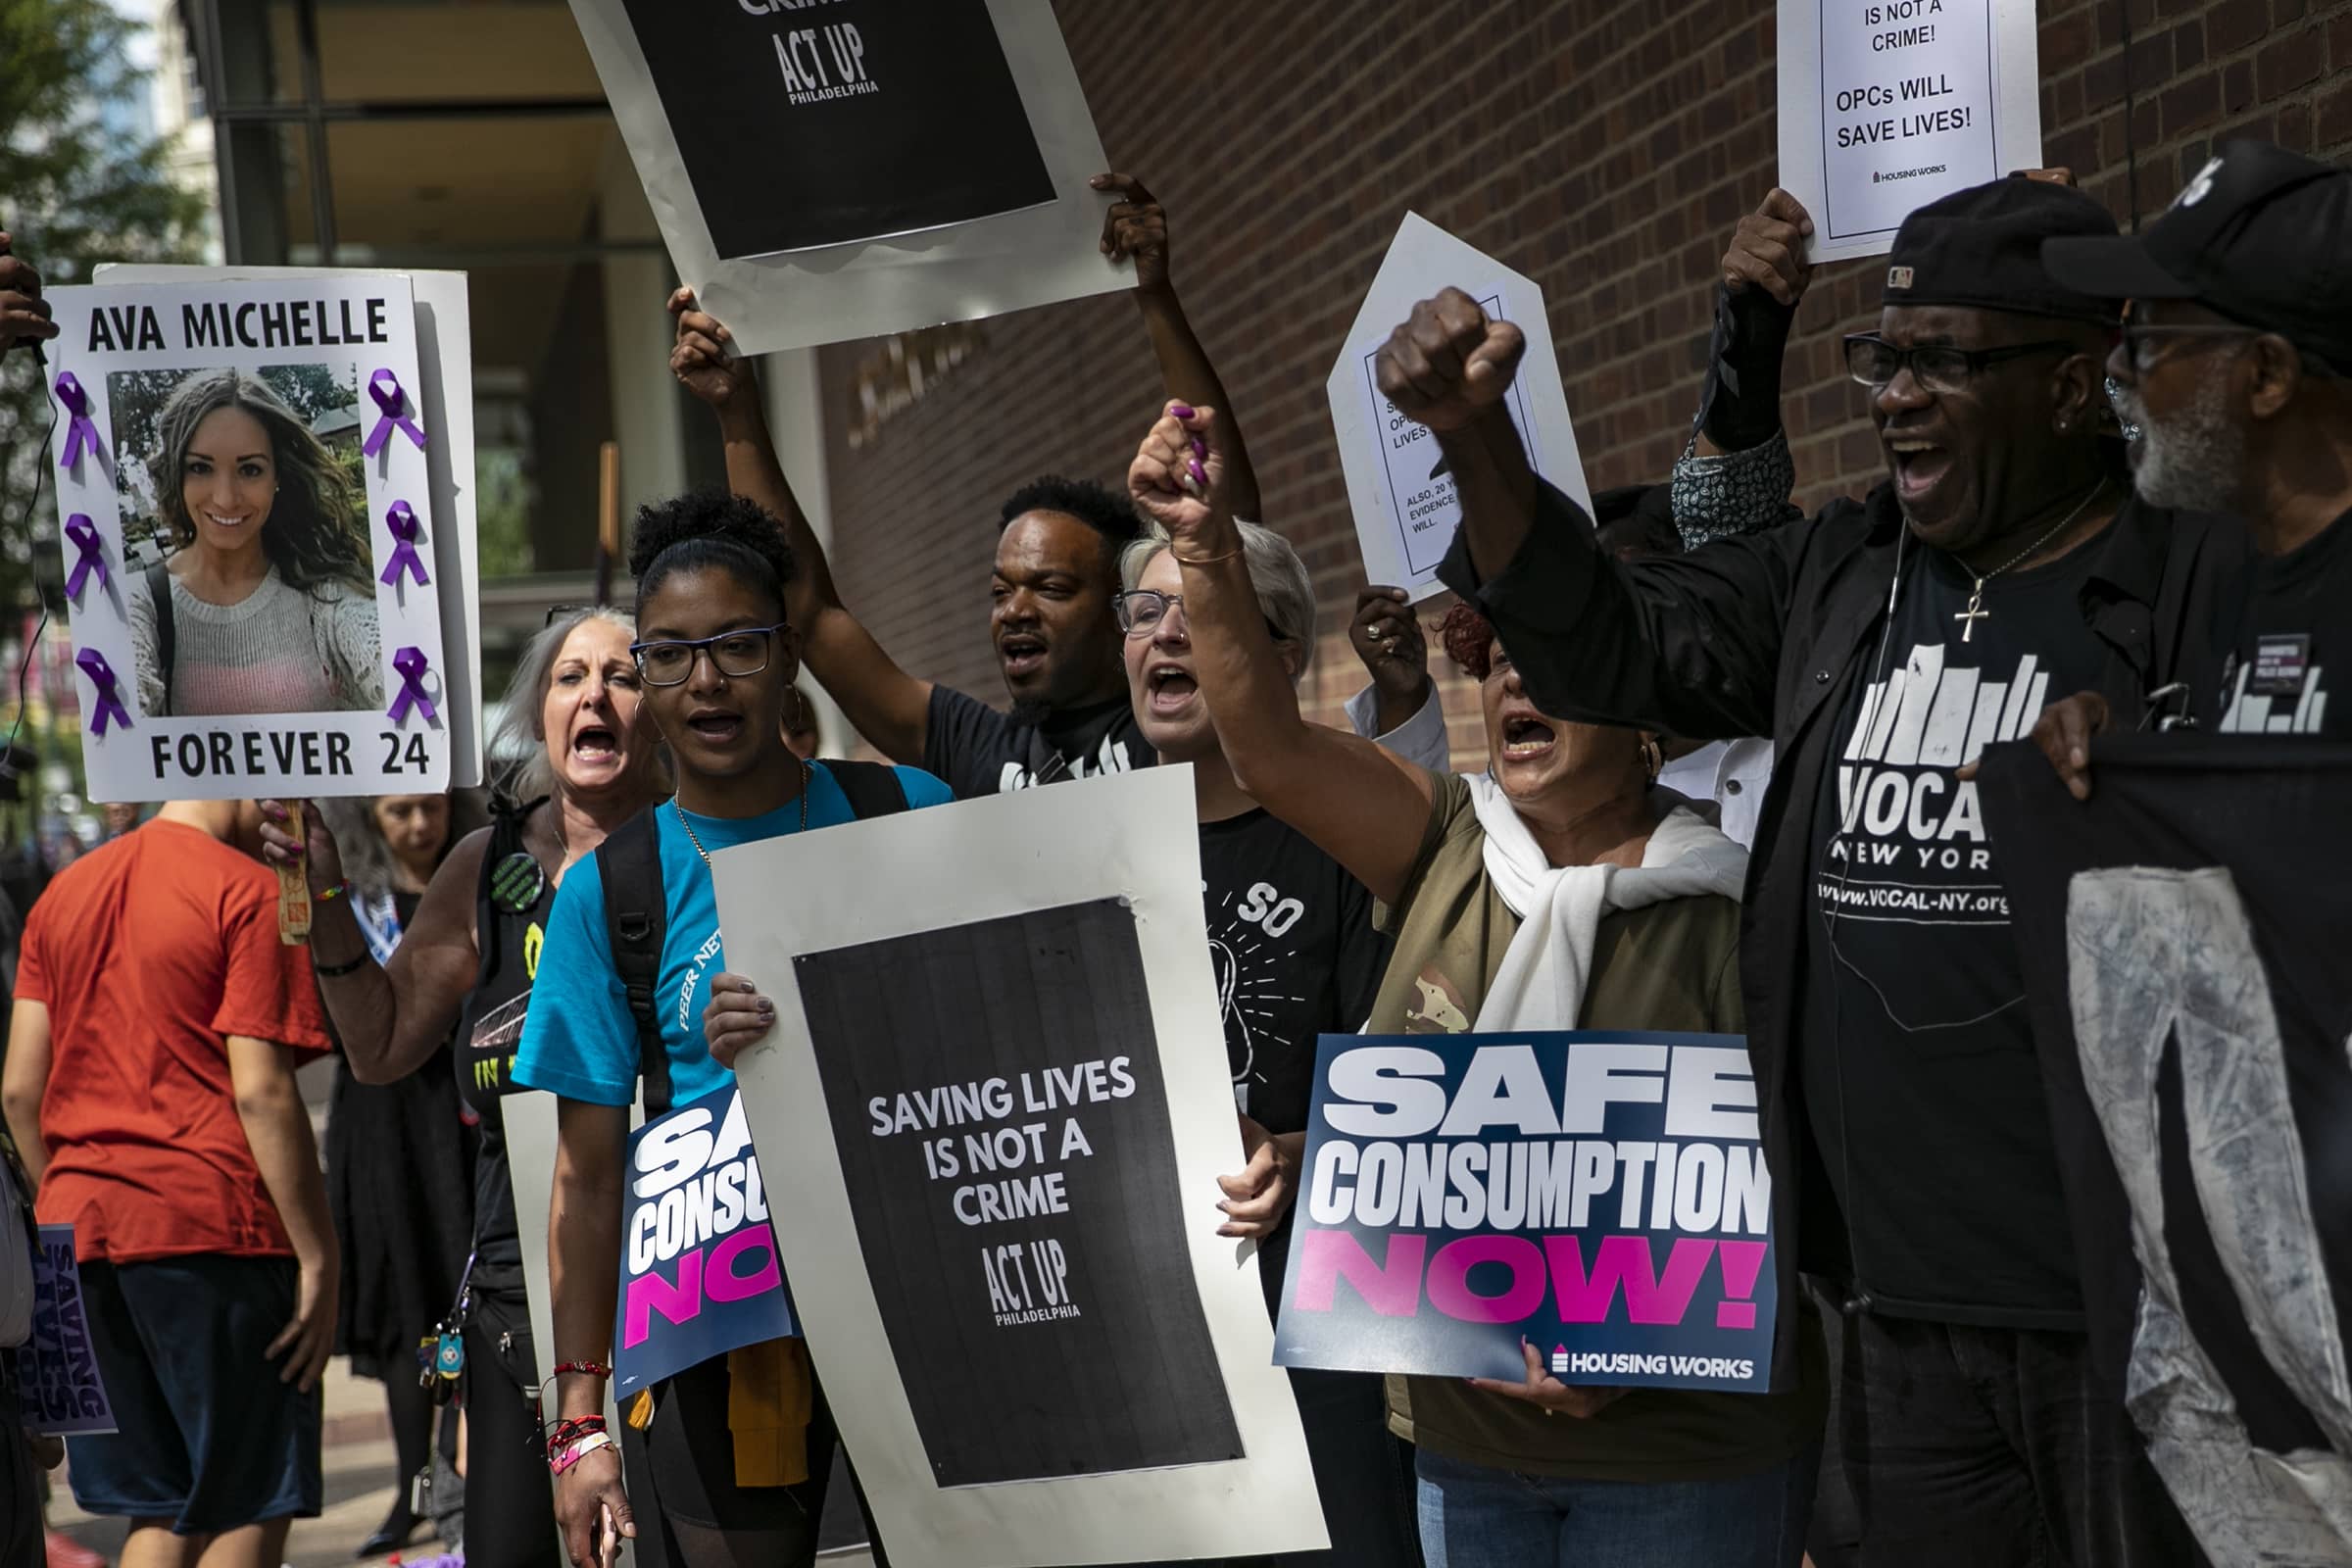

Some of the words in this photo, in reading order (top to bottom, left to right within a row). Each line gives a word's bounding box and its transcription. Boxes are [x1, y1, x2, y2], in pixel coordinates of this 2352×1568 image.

[1865, 7, 1881, 25] IS
[1886, 0, 1925, 22] NOT
[1929, 0, 1942, 14] A
[1872, 24, 1936, 52] CRIME!
[772, 28, 829, 93] ACT
[823, 23, 867, 83] UP
[788, 80, 879, 106] PHILADELPHIA
[1836, 85, 1893, 112] OPCs
[1899, 74, 1953, 101] WILL
[1837, 120, 1895, 148] SAVE
[1902, 106, 1971, 137] LIVES!
[1881, 169, 1917, 182] HOUSING
[1917, 165, 1946, 177] WORKS
[88, 305, 166, 353] AVA
[182, 298, 388, 349] MICHELLE
[1409, 493, 1456, 521] EVIDENCE
[1435, 483, 1446, 496] 20
[150, 731, 353, 779] FOREVER
[379, 732, 430, 775] 24
[1838, 765, 1991, 841] VOCA
[1831, 839, 1901, 865] NEW
[1917, 847, 1990, 870] YOR
[1238, 882, 1304, 938] SO
[679, 967, 700, 1032] PEER
[474, 1057, 499, 1091] IN
[868, 1077, 1014, 1137] SAVING
[1020, 1055, 1137, 1113] LIVES
[1323, 1044, 1761, 1140] SAFE
[632, 1088, 754, 1199] SA
[922, 1138, 960, 1180] IS
[963, 1122, 1048, 1174] NOT
[1059, 1117, 1094, 1160] A
[953, 1172, 1070, 1226] CRIME
[1309, 1139, 1772, 1235] CONSUMPTION
[623, 1222, 782, 1349] NO
[981, 1244, 1034, 1313] ACT
[1029, 1238, 1070, 1306] UP
[1294, 1228, 1768, 1330] NOW!
[33, 1245, 81, 1421] LIVES
[53, 1244, 107, 1419] SAVING
[995, 1304, 1082, 1327] PHILADELPHIA
[1570, 1352, 1668, 1375] HOUSING
[1669, 1355, 1754, 1380] WORKS
